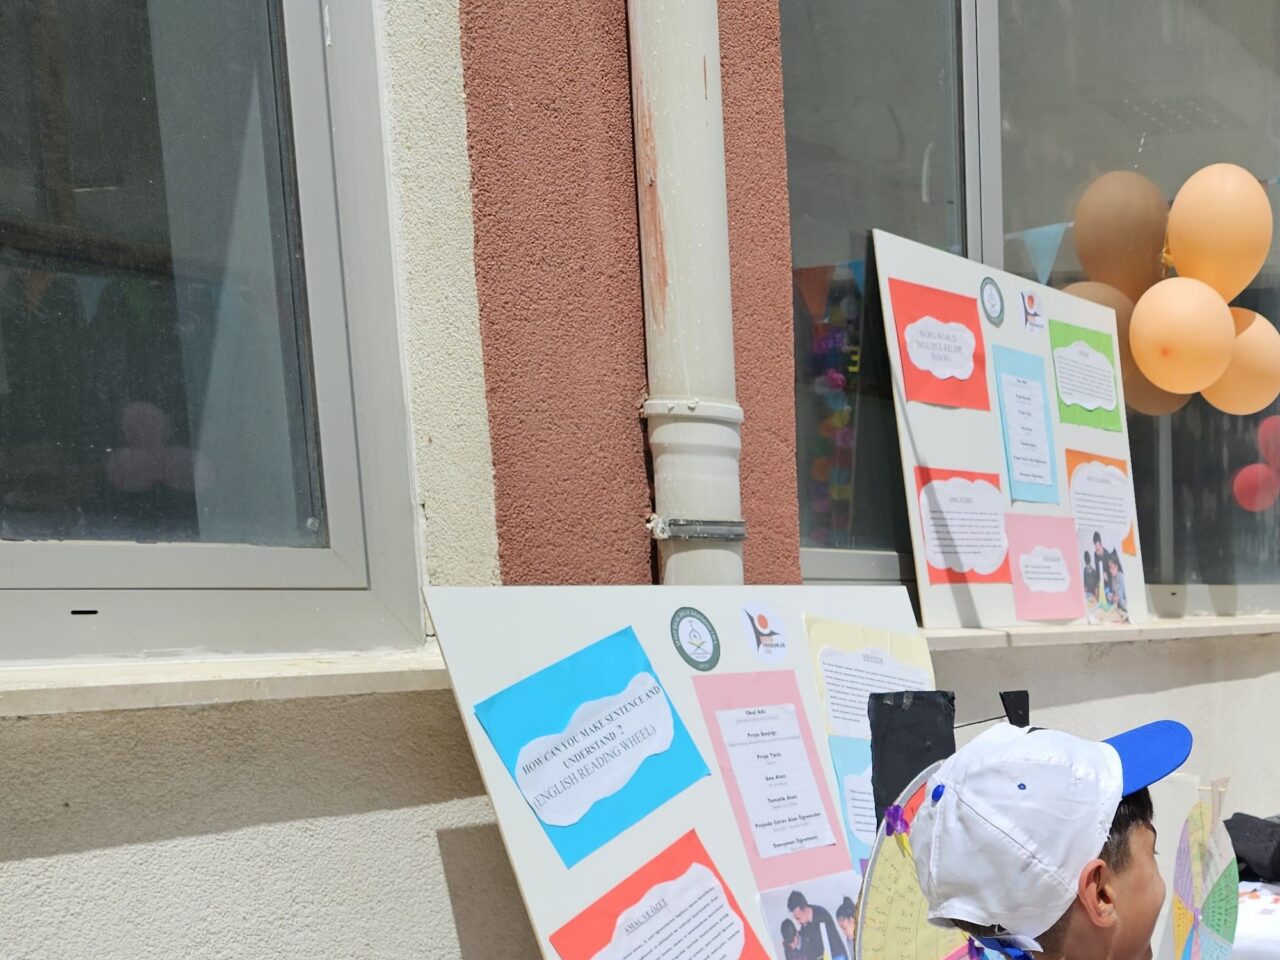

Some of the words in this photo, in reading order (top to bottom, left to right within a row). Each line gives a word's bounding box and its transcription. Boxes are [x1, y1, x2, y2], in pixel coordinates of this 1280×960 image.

[522, 753, 544, 775] HOW
[544, 744, 562, 763] CAN
[561, 734, 582, 752] YOU
[580, 719, 606, 739] MAKE
[605, 696, 645, 725] SENTENCE
[645, 685, 662, 702] AND
[533, 772, 579, 811] (ENGLISH
[578, 748, 622, 780] READING
[620, 725, 657, 752] WHEEL)
[562, 731, 617, 769] UNDERSTAND
